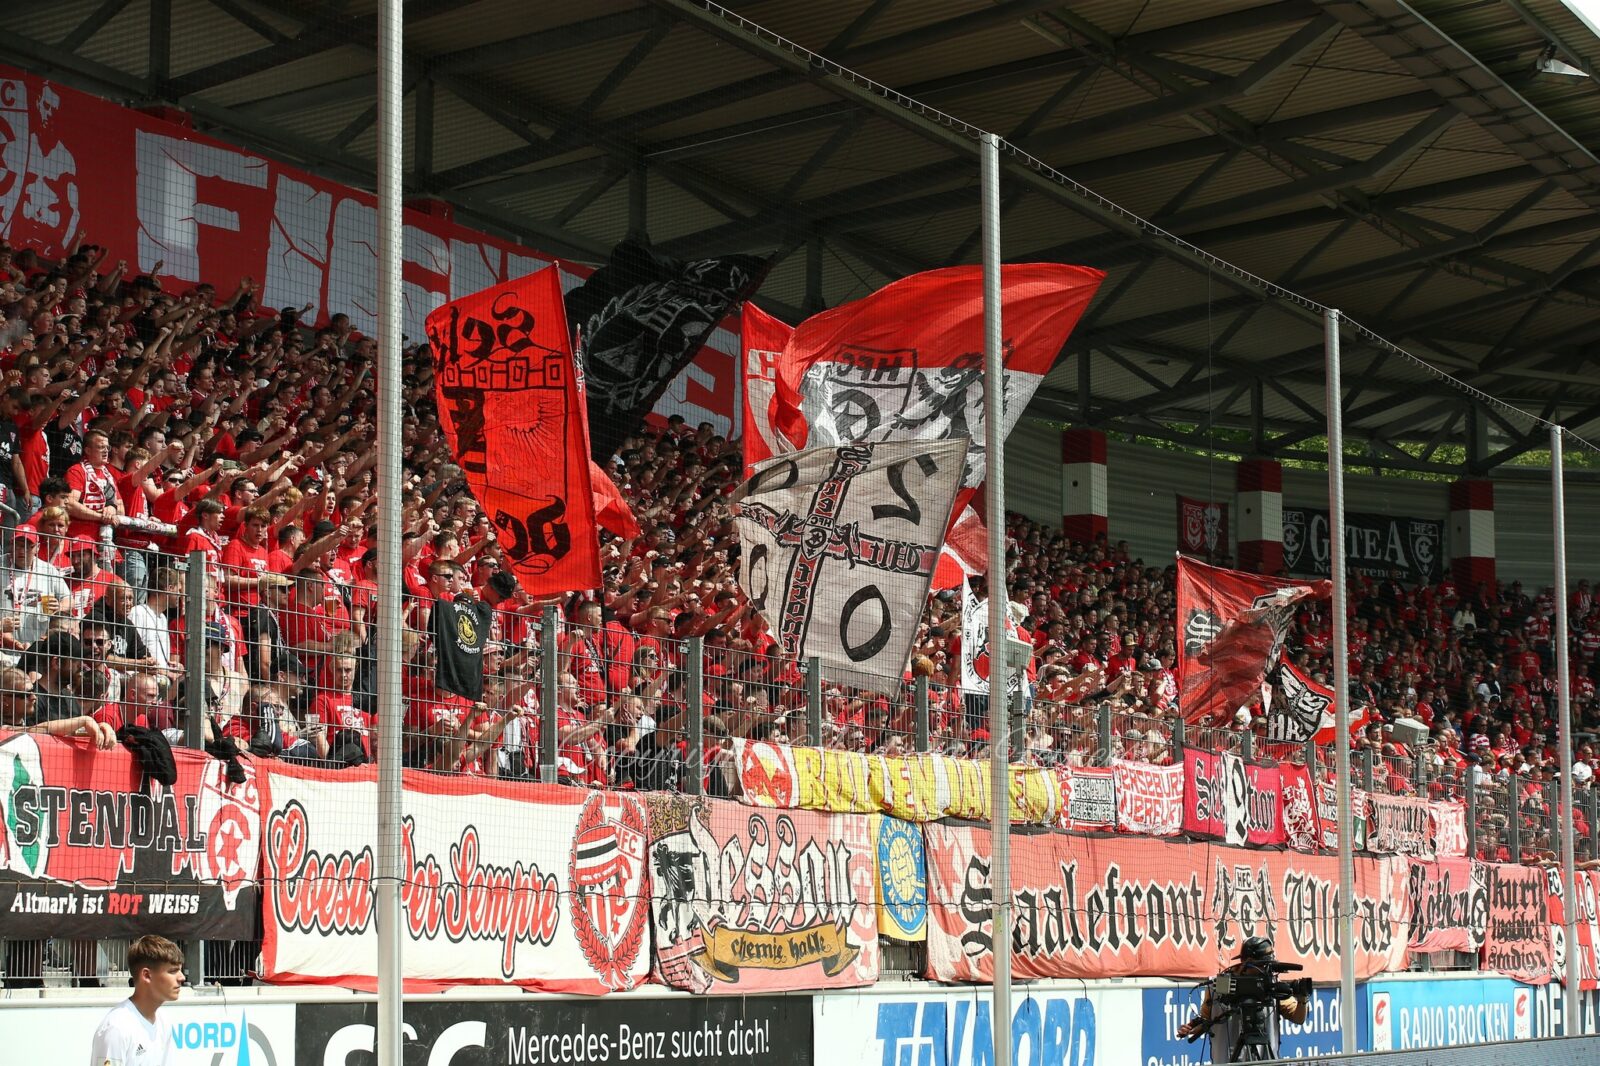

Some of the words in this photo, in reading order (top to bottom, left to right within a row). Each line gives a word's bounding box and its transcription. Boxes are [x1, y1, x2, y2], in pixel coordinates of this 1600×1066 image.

[12, 785, 208, 853] STENDAL
[442, 823, 561, 980] Sempre
[1236, 868, 1252, 888] HFC
[10, 892, 79, 915] Altmark
[81, 892, 105, 914] ist
[108, 892, 144, 915] ROT
[148, 893, 200, 915] WEISS
[960, 854, 1208, 957] Saalefront
[508, 1023, 666, 1066] Mercedes-Benz
[671, 1020, 722, 1058] sucht
[727, 1018, 770, 1056] dich!
[1399, 1005, 1445, 1050] RADIO
[1447, 1002, 1510, 1046] BROCKEN
